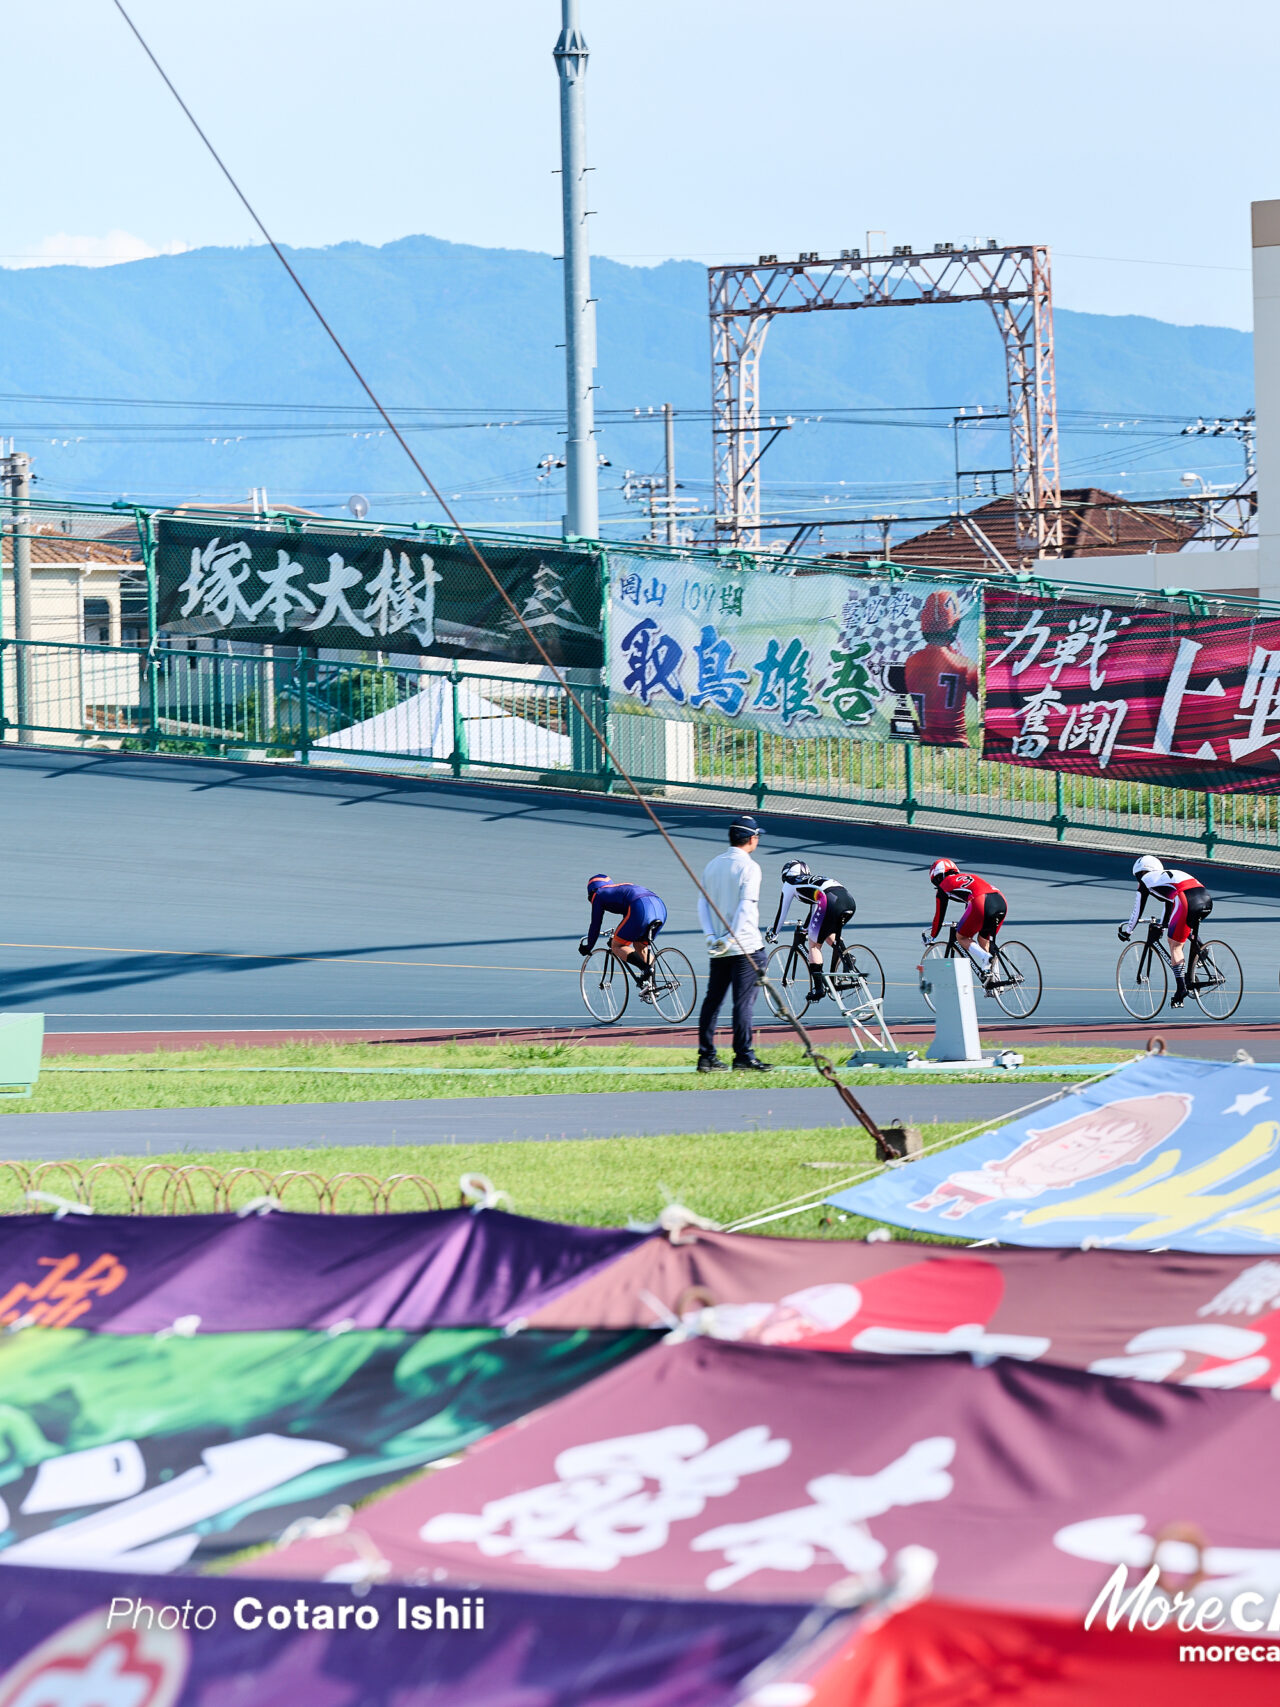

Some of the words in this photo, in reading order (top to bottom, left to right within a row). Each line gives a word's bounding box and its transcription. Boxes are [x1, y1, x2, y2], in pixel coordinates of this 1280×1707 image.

[178, 537, 443, 647] 塚本大樹
[1011, 684, 1126, 770] 奮闘
